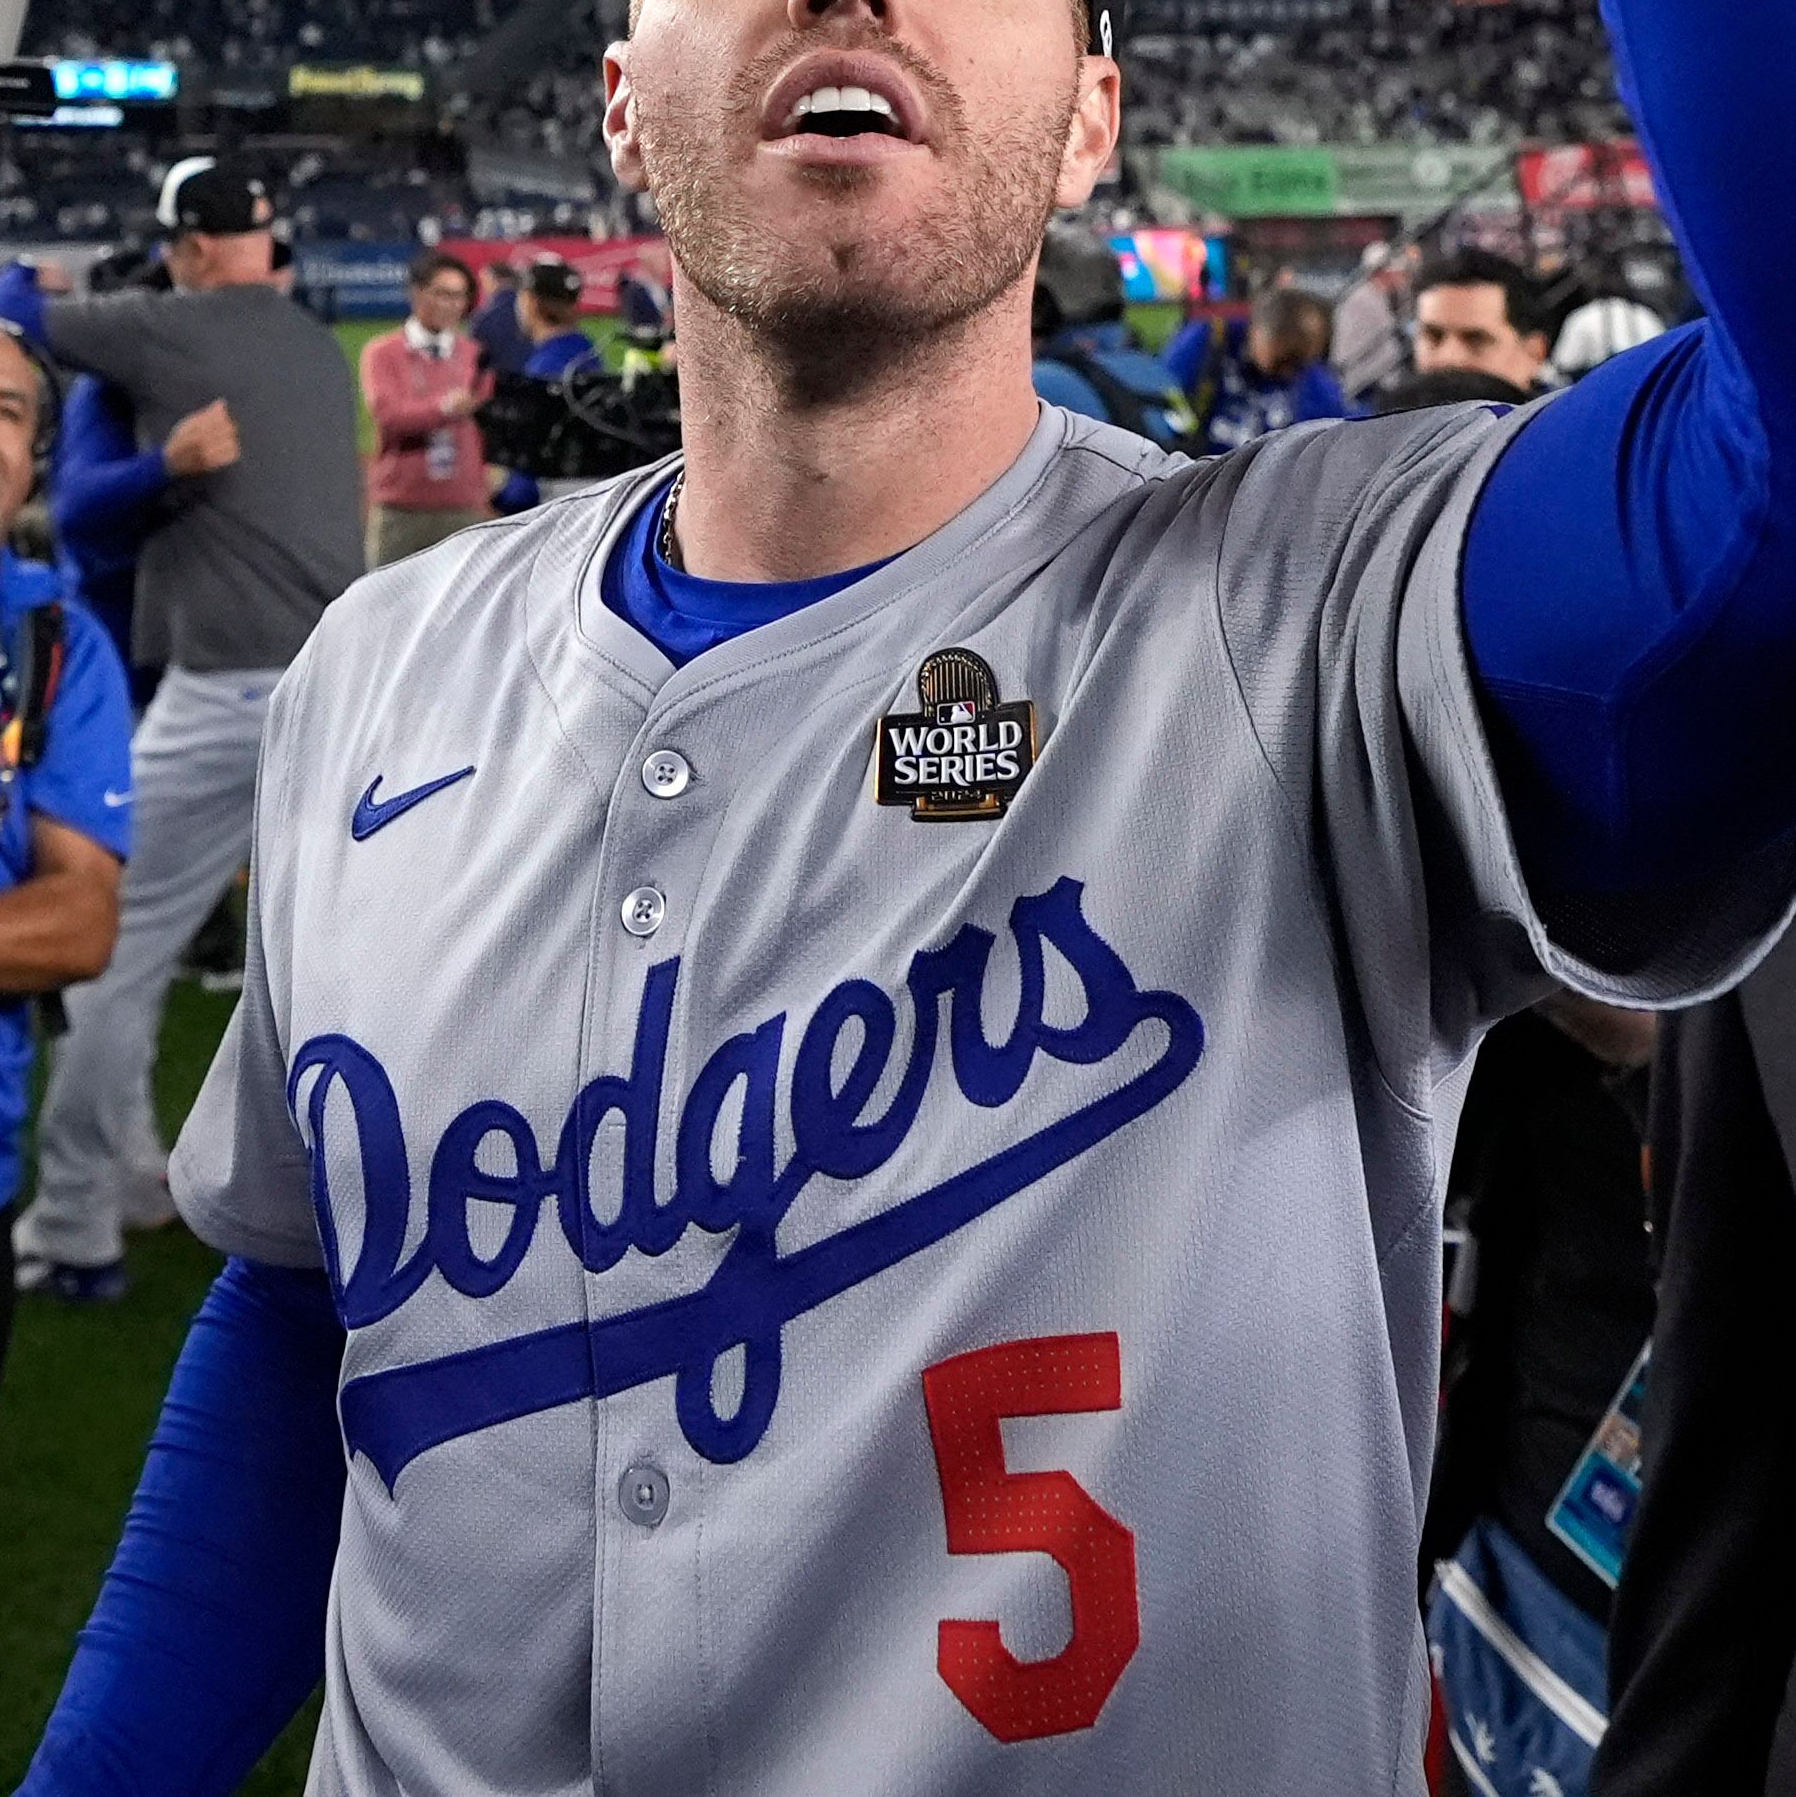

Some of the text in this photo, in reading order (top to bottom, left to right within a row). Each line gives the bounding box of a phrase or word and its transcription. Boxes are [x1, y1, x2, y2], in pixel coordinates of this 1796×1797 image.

[888, 721, 1023, 758] WORLD
[894, 750, 1020, 787] SERIES
[288, 875, 1205, 1478] Dodgers
[920, 1330, 1141, 1744] 5
